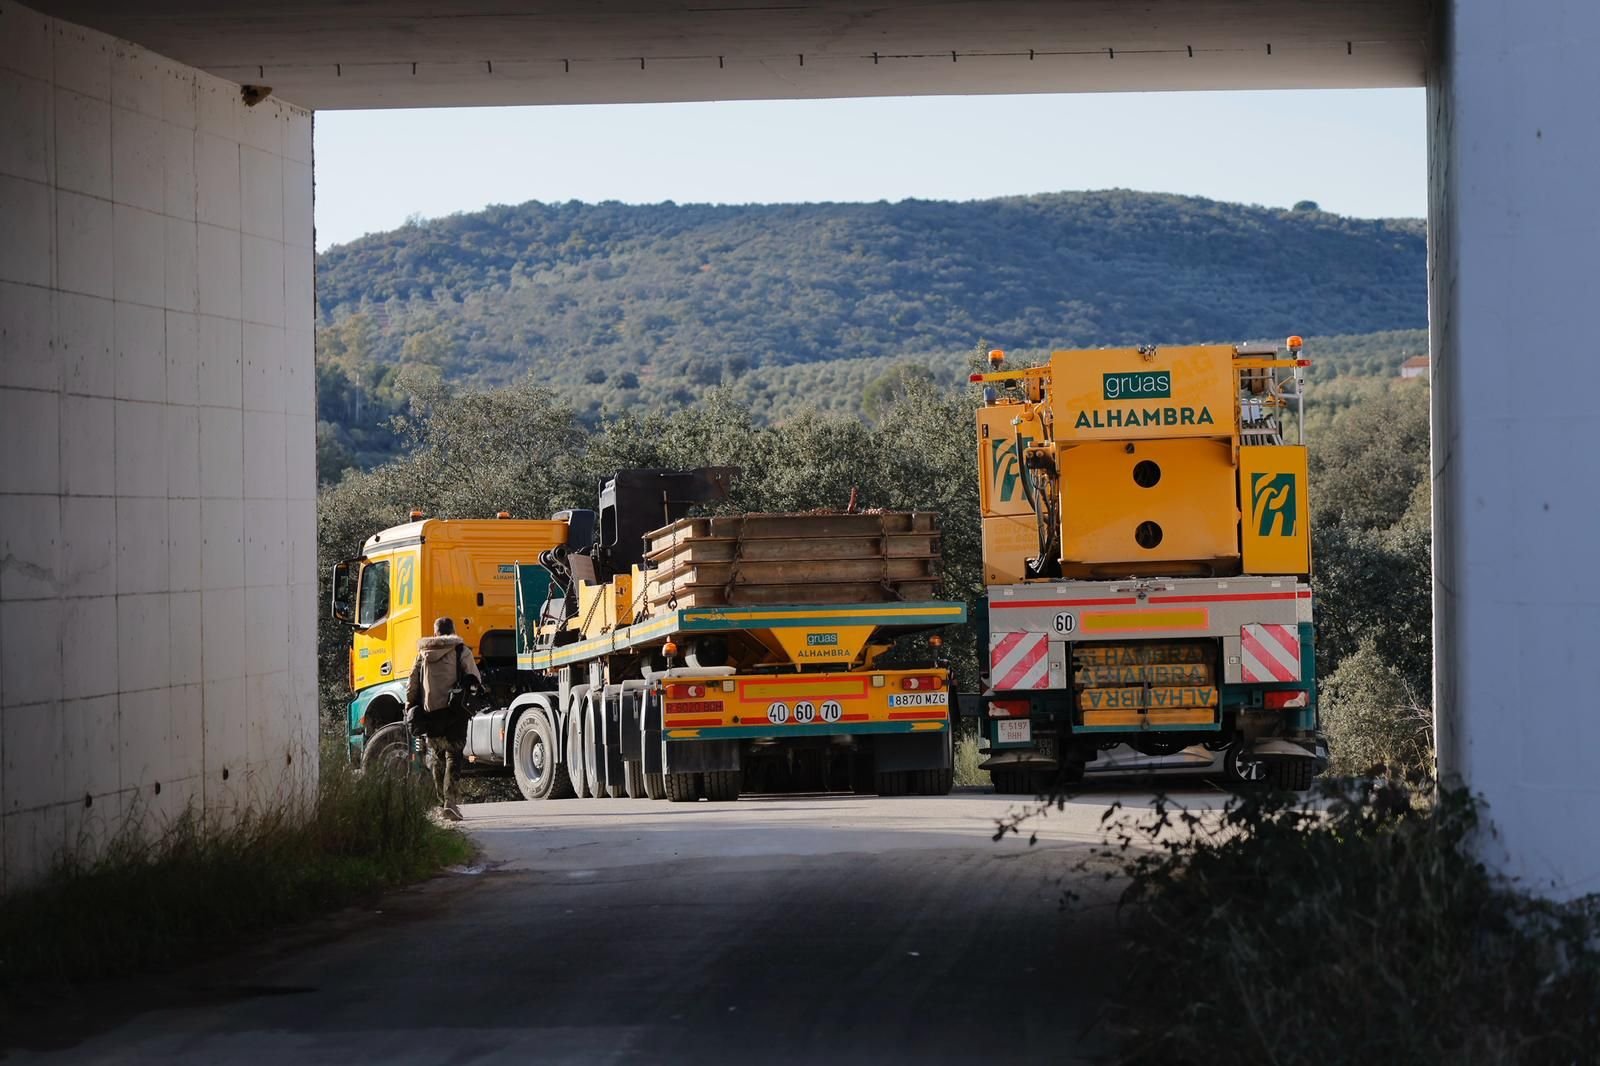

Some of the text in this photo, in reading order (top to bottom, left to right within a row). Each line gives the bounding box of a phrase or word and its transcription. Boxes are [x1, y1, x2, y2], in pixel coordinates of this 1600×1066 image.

[1105, 374, 1169, 399] grúas
[1074, 406, 1215, 429] ALHAMBRA
[1056, 615, 1073, 631] 60
[798, 649, 851, 658] ALHAMBRA
[895, 694, 946, 705] 8870 MZG
[769, 704, 786, 722] 40
[796, 704, 813, 720] 60
[822, 704, 839, 719] 70
